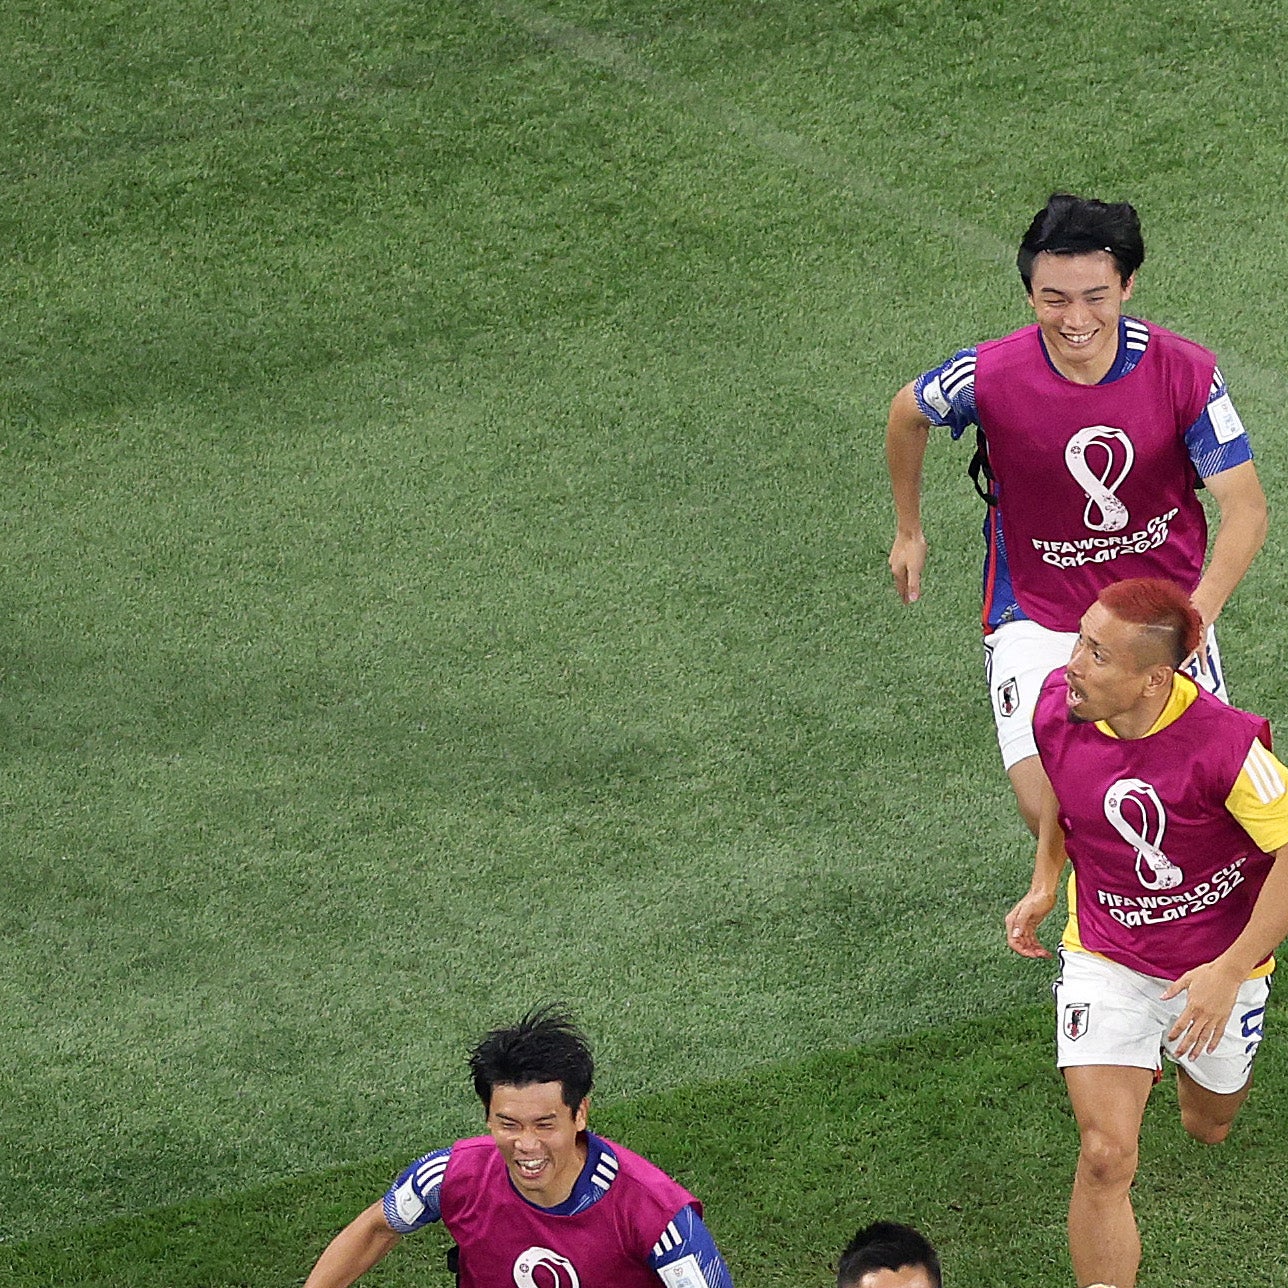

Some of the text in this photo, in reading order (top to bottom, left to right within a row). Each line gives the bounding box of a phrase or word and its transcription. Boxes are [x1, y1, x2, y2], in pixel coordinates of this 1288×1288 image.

[1031, 507, 1179, 553] FIFA WORLD CUP
[1097, 857, 1247, 909] FIFA WORLD CUP
